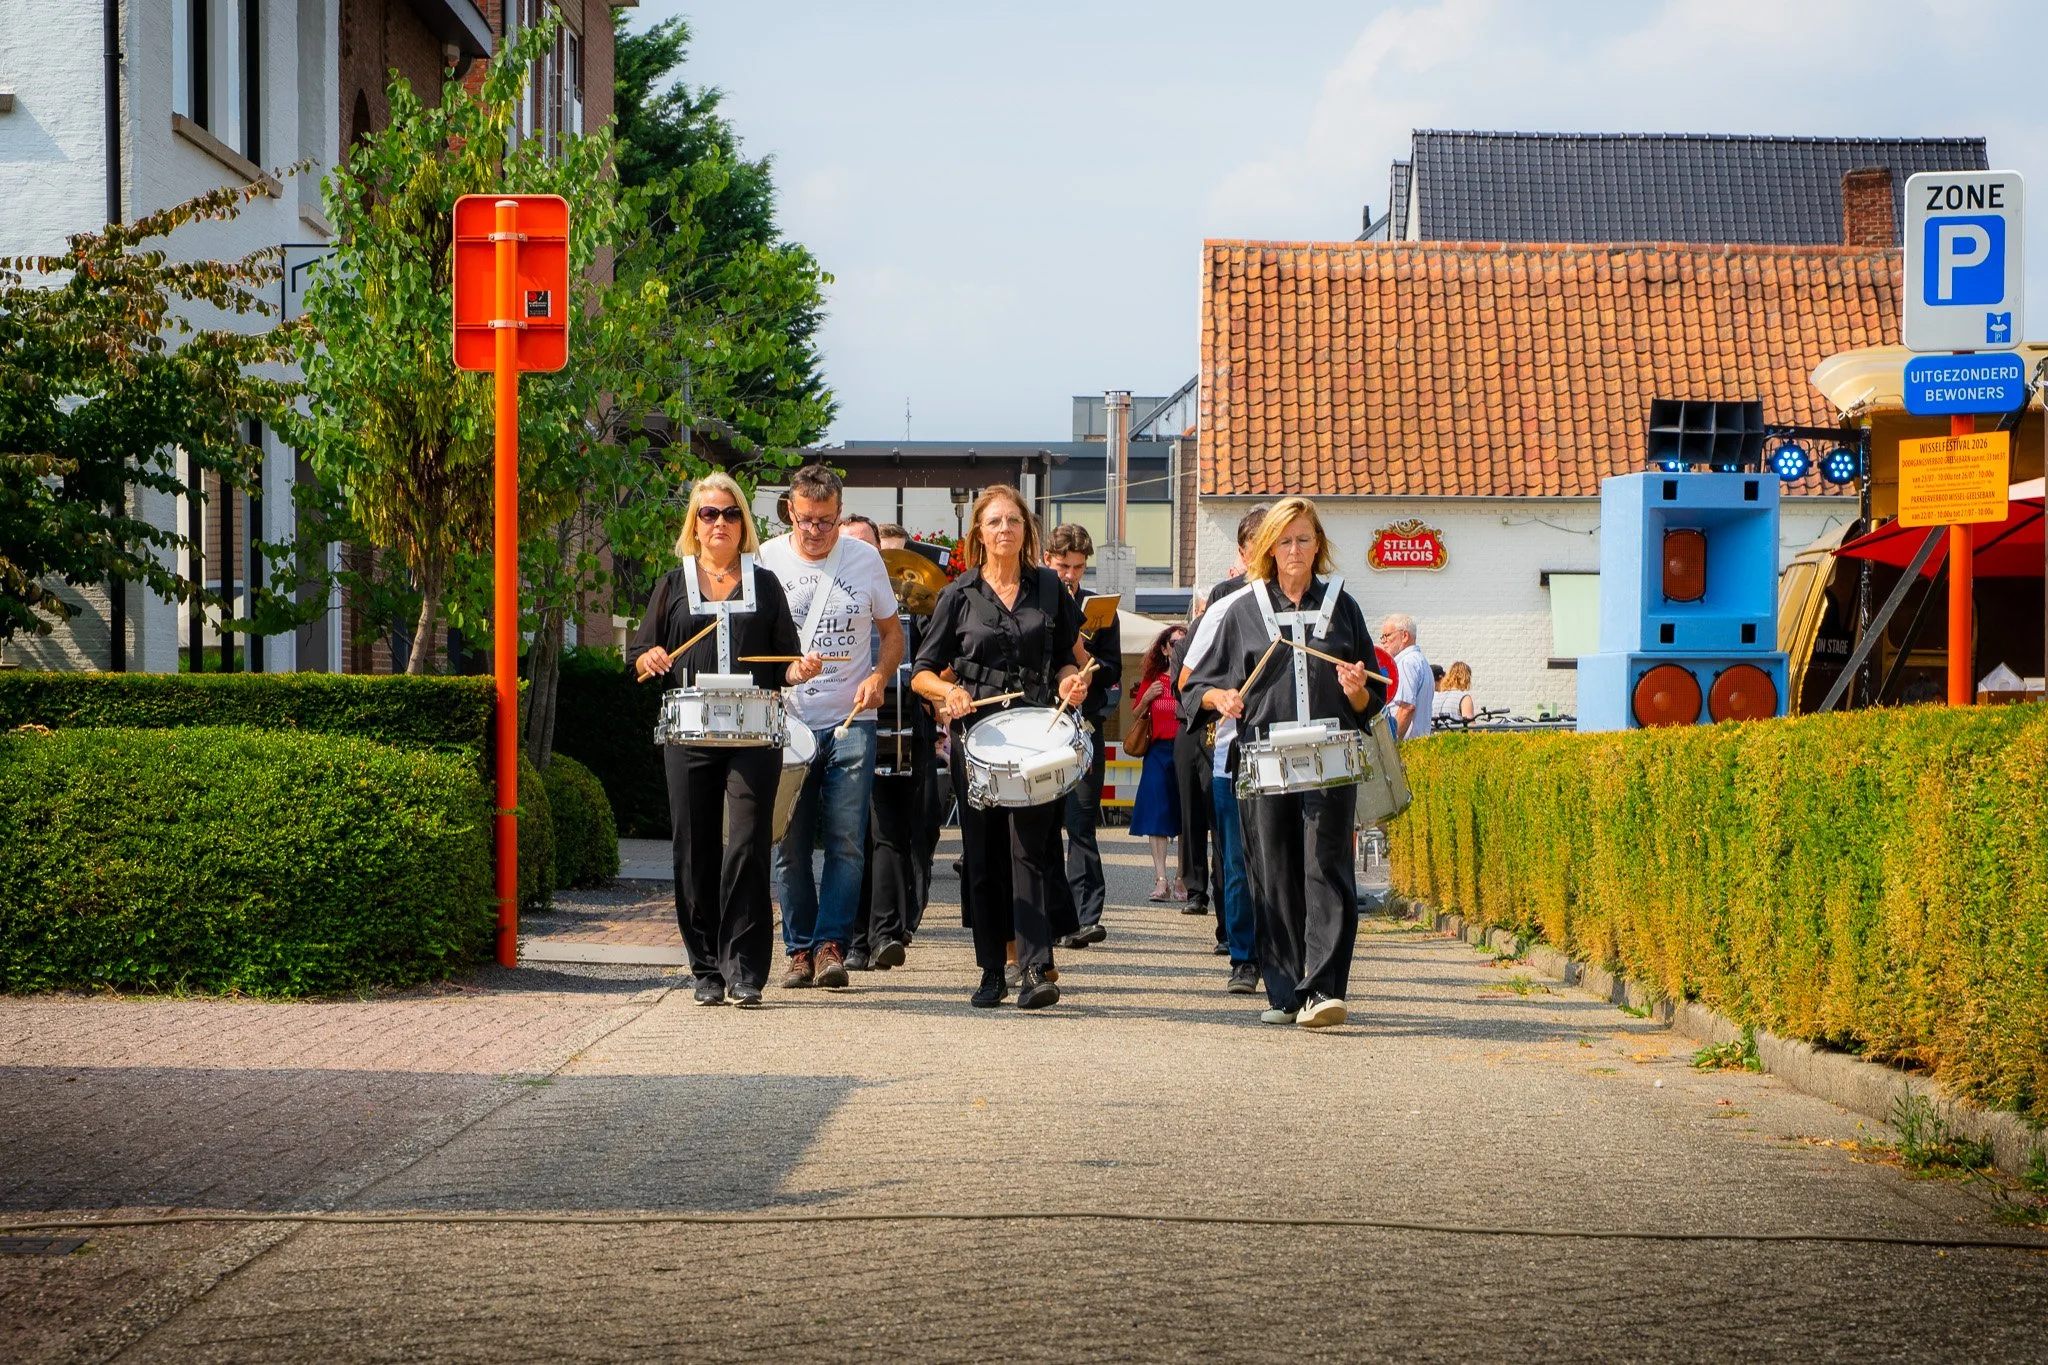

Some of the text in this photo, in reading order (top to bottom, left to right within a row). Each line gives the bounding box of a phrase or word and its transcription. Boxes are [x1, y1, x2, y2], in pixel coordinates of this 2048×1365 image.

[1926, 184, 2004, 210] ZONE
[1938, 224, 1990, 300] P
[1911, 366, 2018, 383] UITGEZONDERD
[1926, 386, 2004, 402] BEWONERS
[1920, 438, 1988, 453] WISSELFESTIVAL 2026
[1911, 494, 1948, 503] PARKEERVERBOD
[1384, 540, 1432, 550] STELLA
[1383, 551, 1433, 561] ARTOIS
[846, 605, 860, 614] 52
[838, 636, 857, 645] CO.
[1816, 638, 1848, 654] ON STAGE
